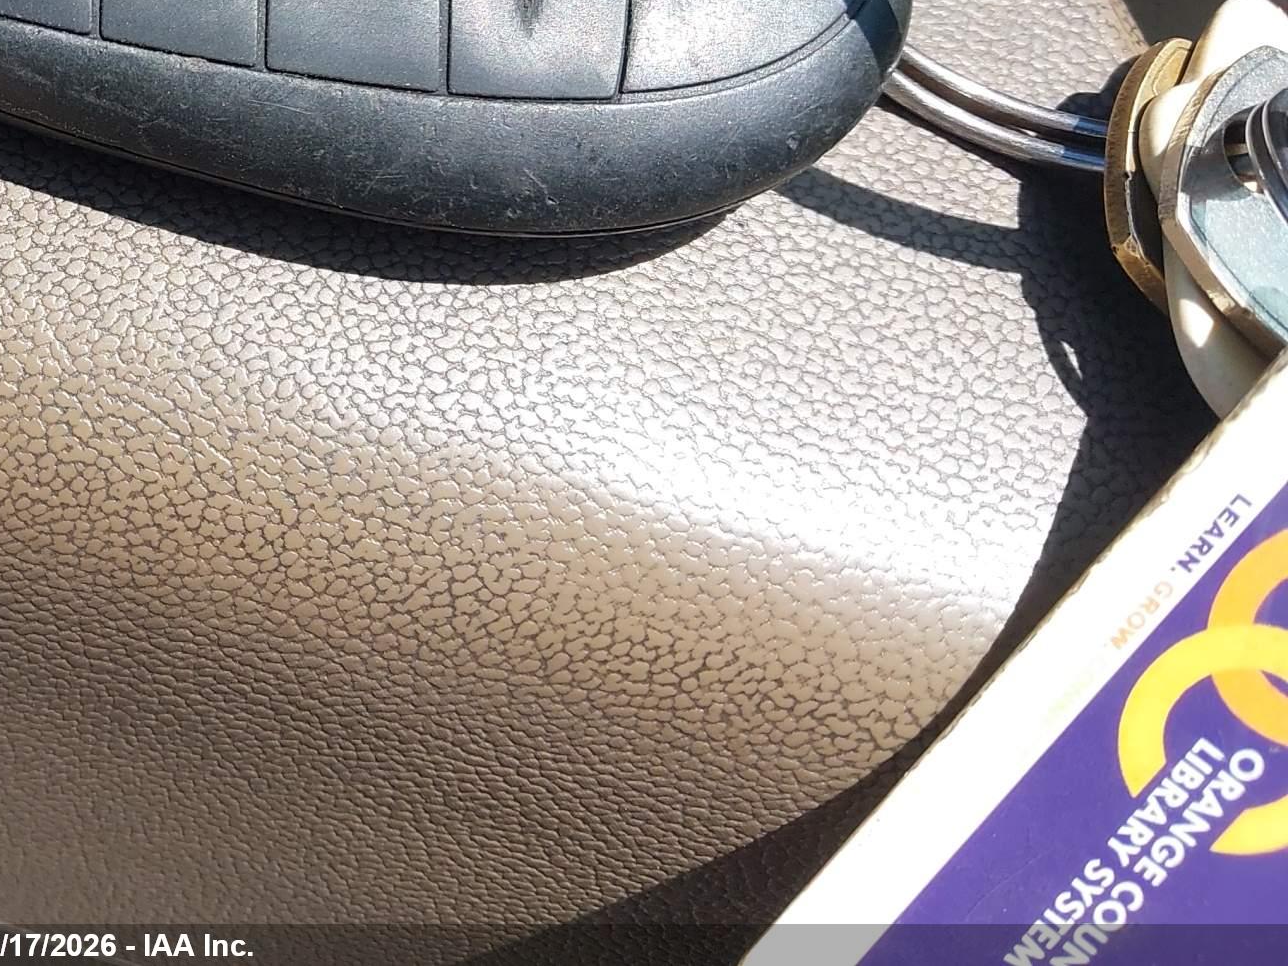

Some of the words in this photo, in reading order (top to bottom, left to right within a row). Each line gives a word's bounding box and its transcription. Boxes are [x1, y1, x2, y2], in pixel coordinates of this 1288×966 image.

[1169, 493, 1253, 573] LEARN.
[1106, 736, 1226, 868] LIBRARY
[1132, 747, 1266, 887] ORANGE
[1002, 857, 1116, 966] SYSTEM
